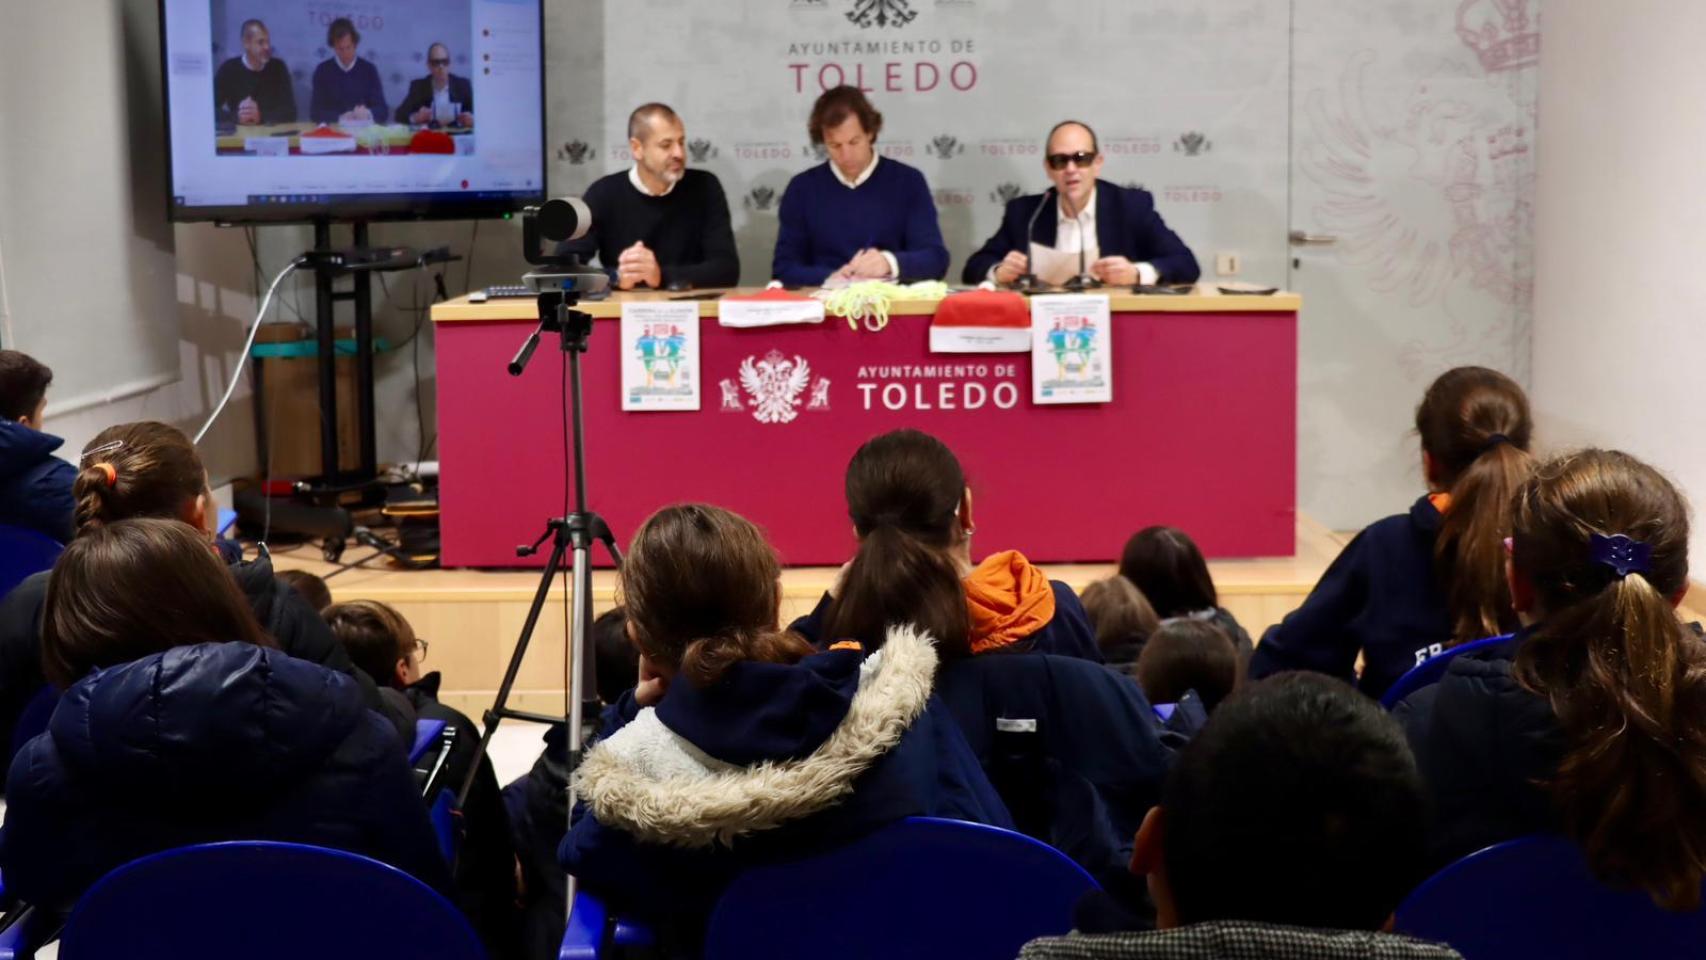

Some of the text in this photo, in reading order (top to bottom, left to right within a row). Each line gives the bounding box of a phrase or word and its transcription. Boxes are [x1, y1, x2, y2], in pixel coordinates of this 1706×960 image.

[788, 40, 975, 56] AYUNTAMIENTO DE
[788, 61, 977, 93] TOLEDO
[734, 147, 791, 160] TOLEDO
[980, 144, 1039, 156] TOLEDO
[1103, 143, 1161, 155] TOLEDO
[1163, 190, 1222, 203] TOLEDO
[857, 365, 1016, 378] AYUNTAMIENTO DE
[857, 382, 1019, 410] TOLEDO
